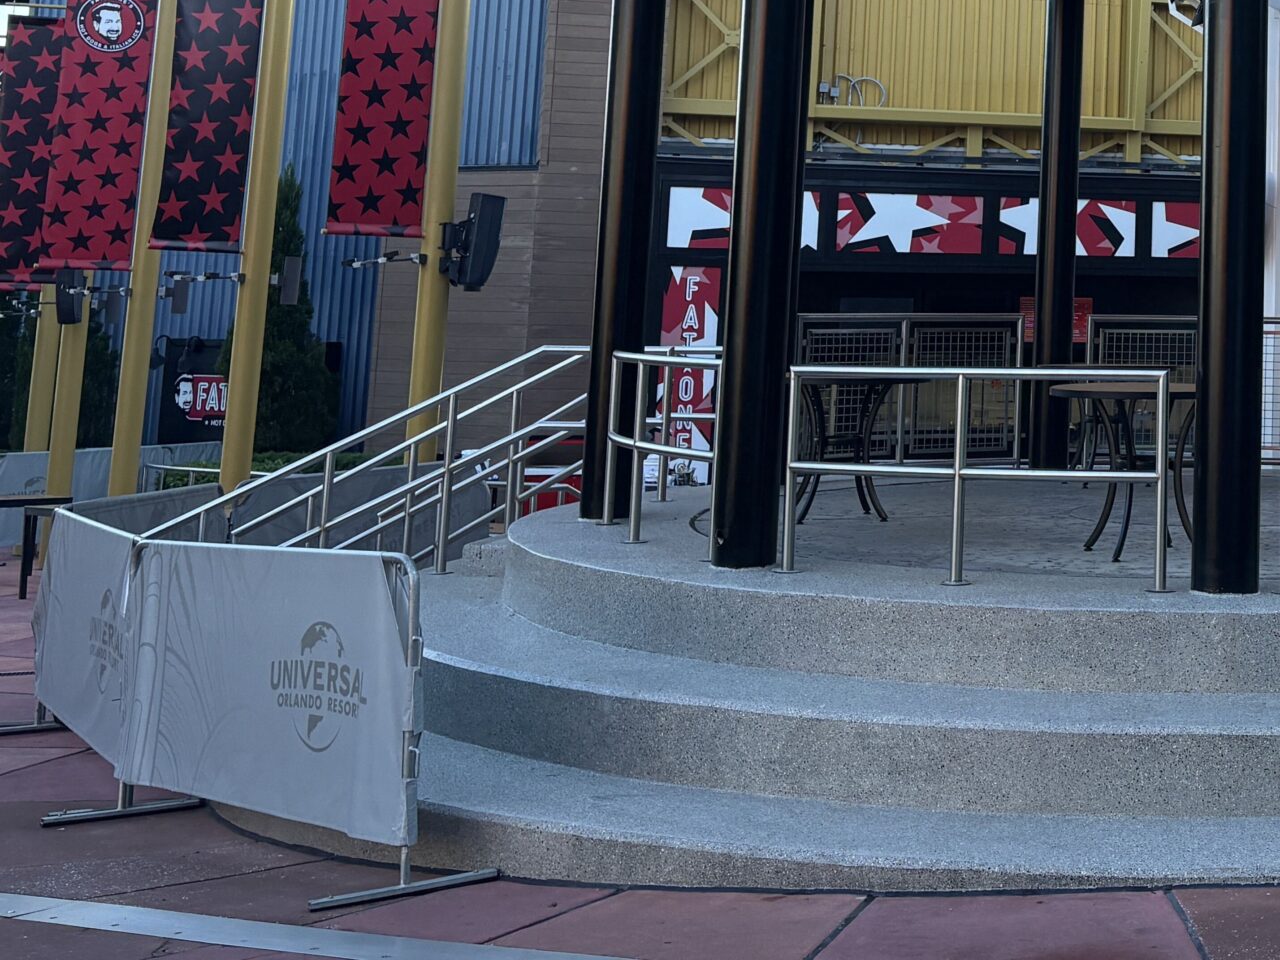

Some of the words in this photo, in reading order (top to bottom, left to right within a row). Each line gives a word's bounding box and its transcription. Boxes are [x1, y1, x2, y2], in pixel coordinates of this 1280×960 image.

[196, 382, 228, 411] FAT
[270, 659, 367, 705] UNIVERSAL
[277, 692, 323, 710] ORLANDO
